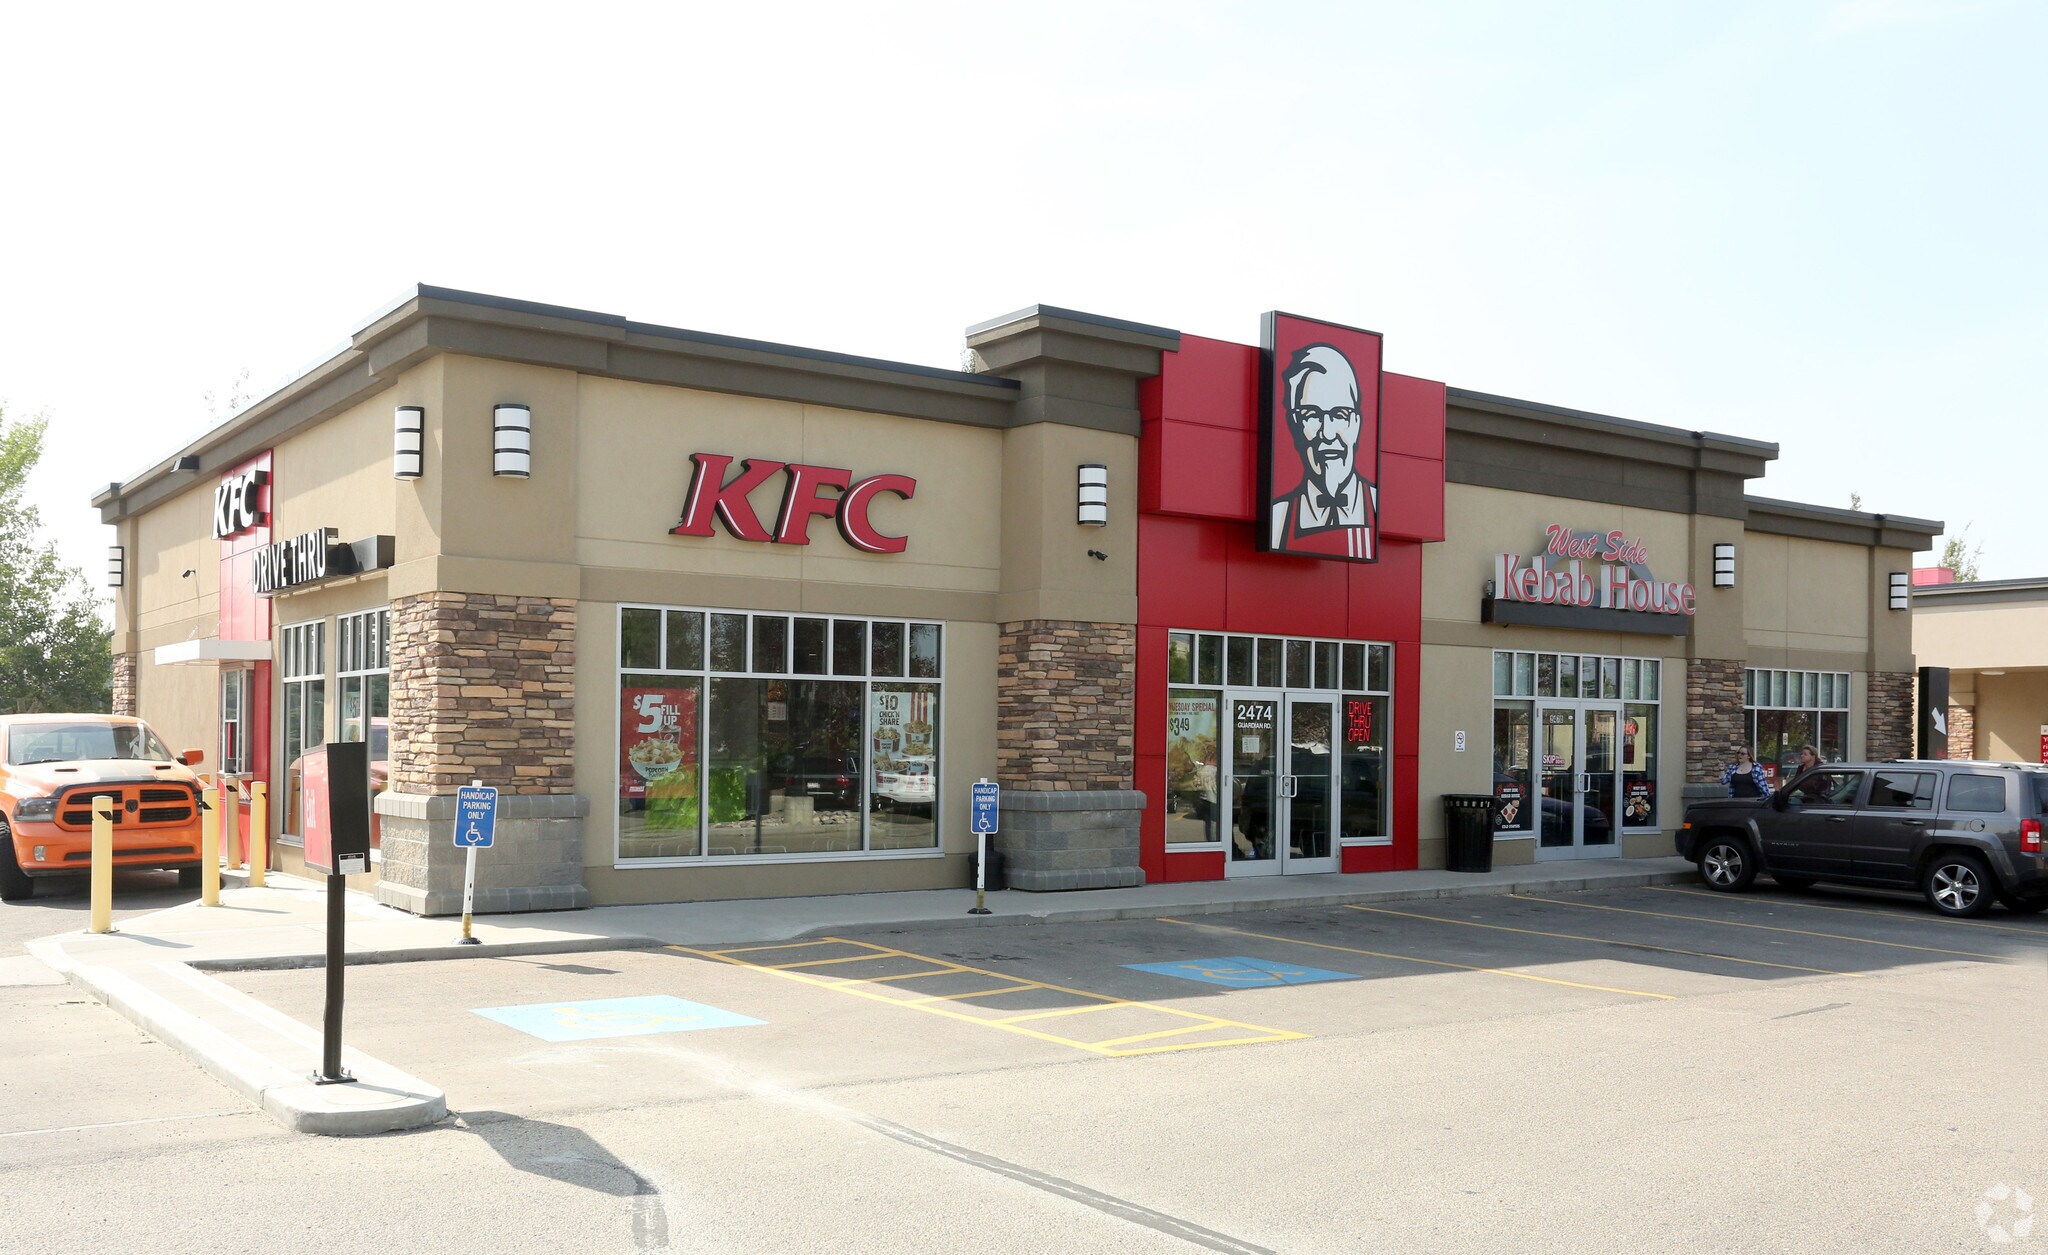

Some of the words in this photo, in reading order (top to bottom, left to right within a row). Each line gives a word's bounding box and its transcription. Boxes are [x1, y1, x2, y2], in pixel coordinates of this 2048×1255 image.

[212, 469, 258, 540] KFC
[668, 453, 917, 553] KFC
[1546, 523, 1599, 558] West
[1602, 530, 1648, 564] Side
[253, 541, 287, 594] DRIVE
[290, 527, 327, 584] THRU
[1497, 554, 1595, 607] Kebab
[1602, 565, 1696, 616] House
[661, 704, 681, 715] FILL
[879, 695, 899, 711] $10
[1191, 702, 1215, 712] SPECIAL
[1348, 701, 1373, 715] DRIVE
[632, 694, 665, 734] $5
[1237, 704, 1273, 721] 2474
[663, 716, 678, 726] UP
[880, 718, 900, 726] SHARE
[1237, 721, 1263, 729] GUARDIAN
[1348, 715, 1372, 729] THRU
[1347, 728, 1371, 742] OPEN
[1542, 754, 1556, 764] SKIP
[461, 791, 495, 800] HANDICAP
[462, 801, 492, 810] PARKING
[979, 803, 991, 811] ONLY
[467, 811, 486, 820] ONLY
